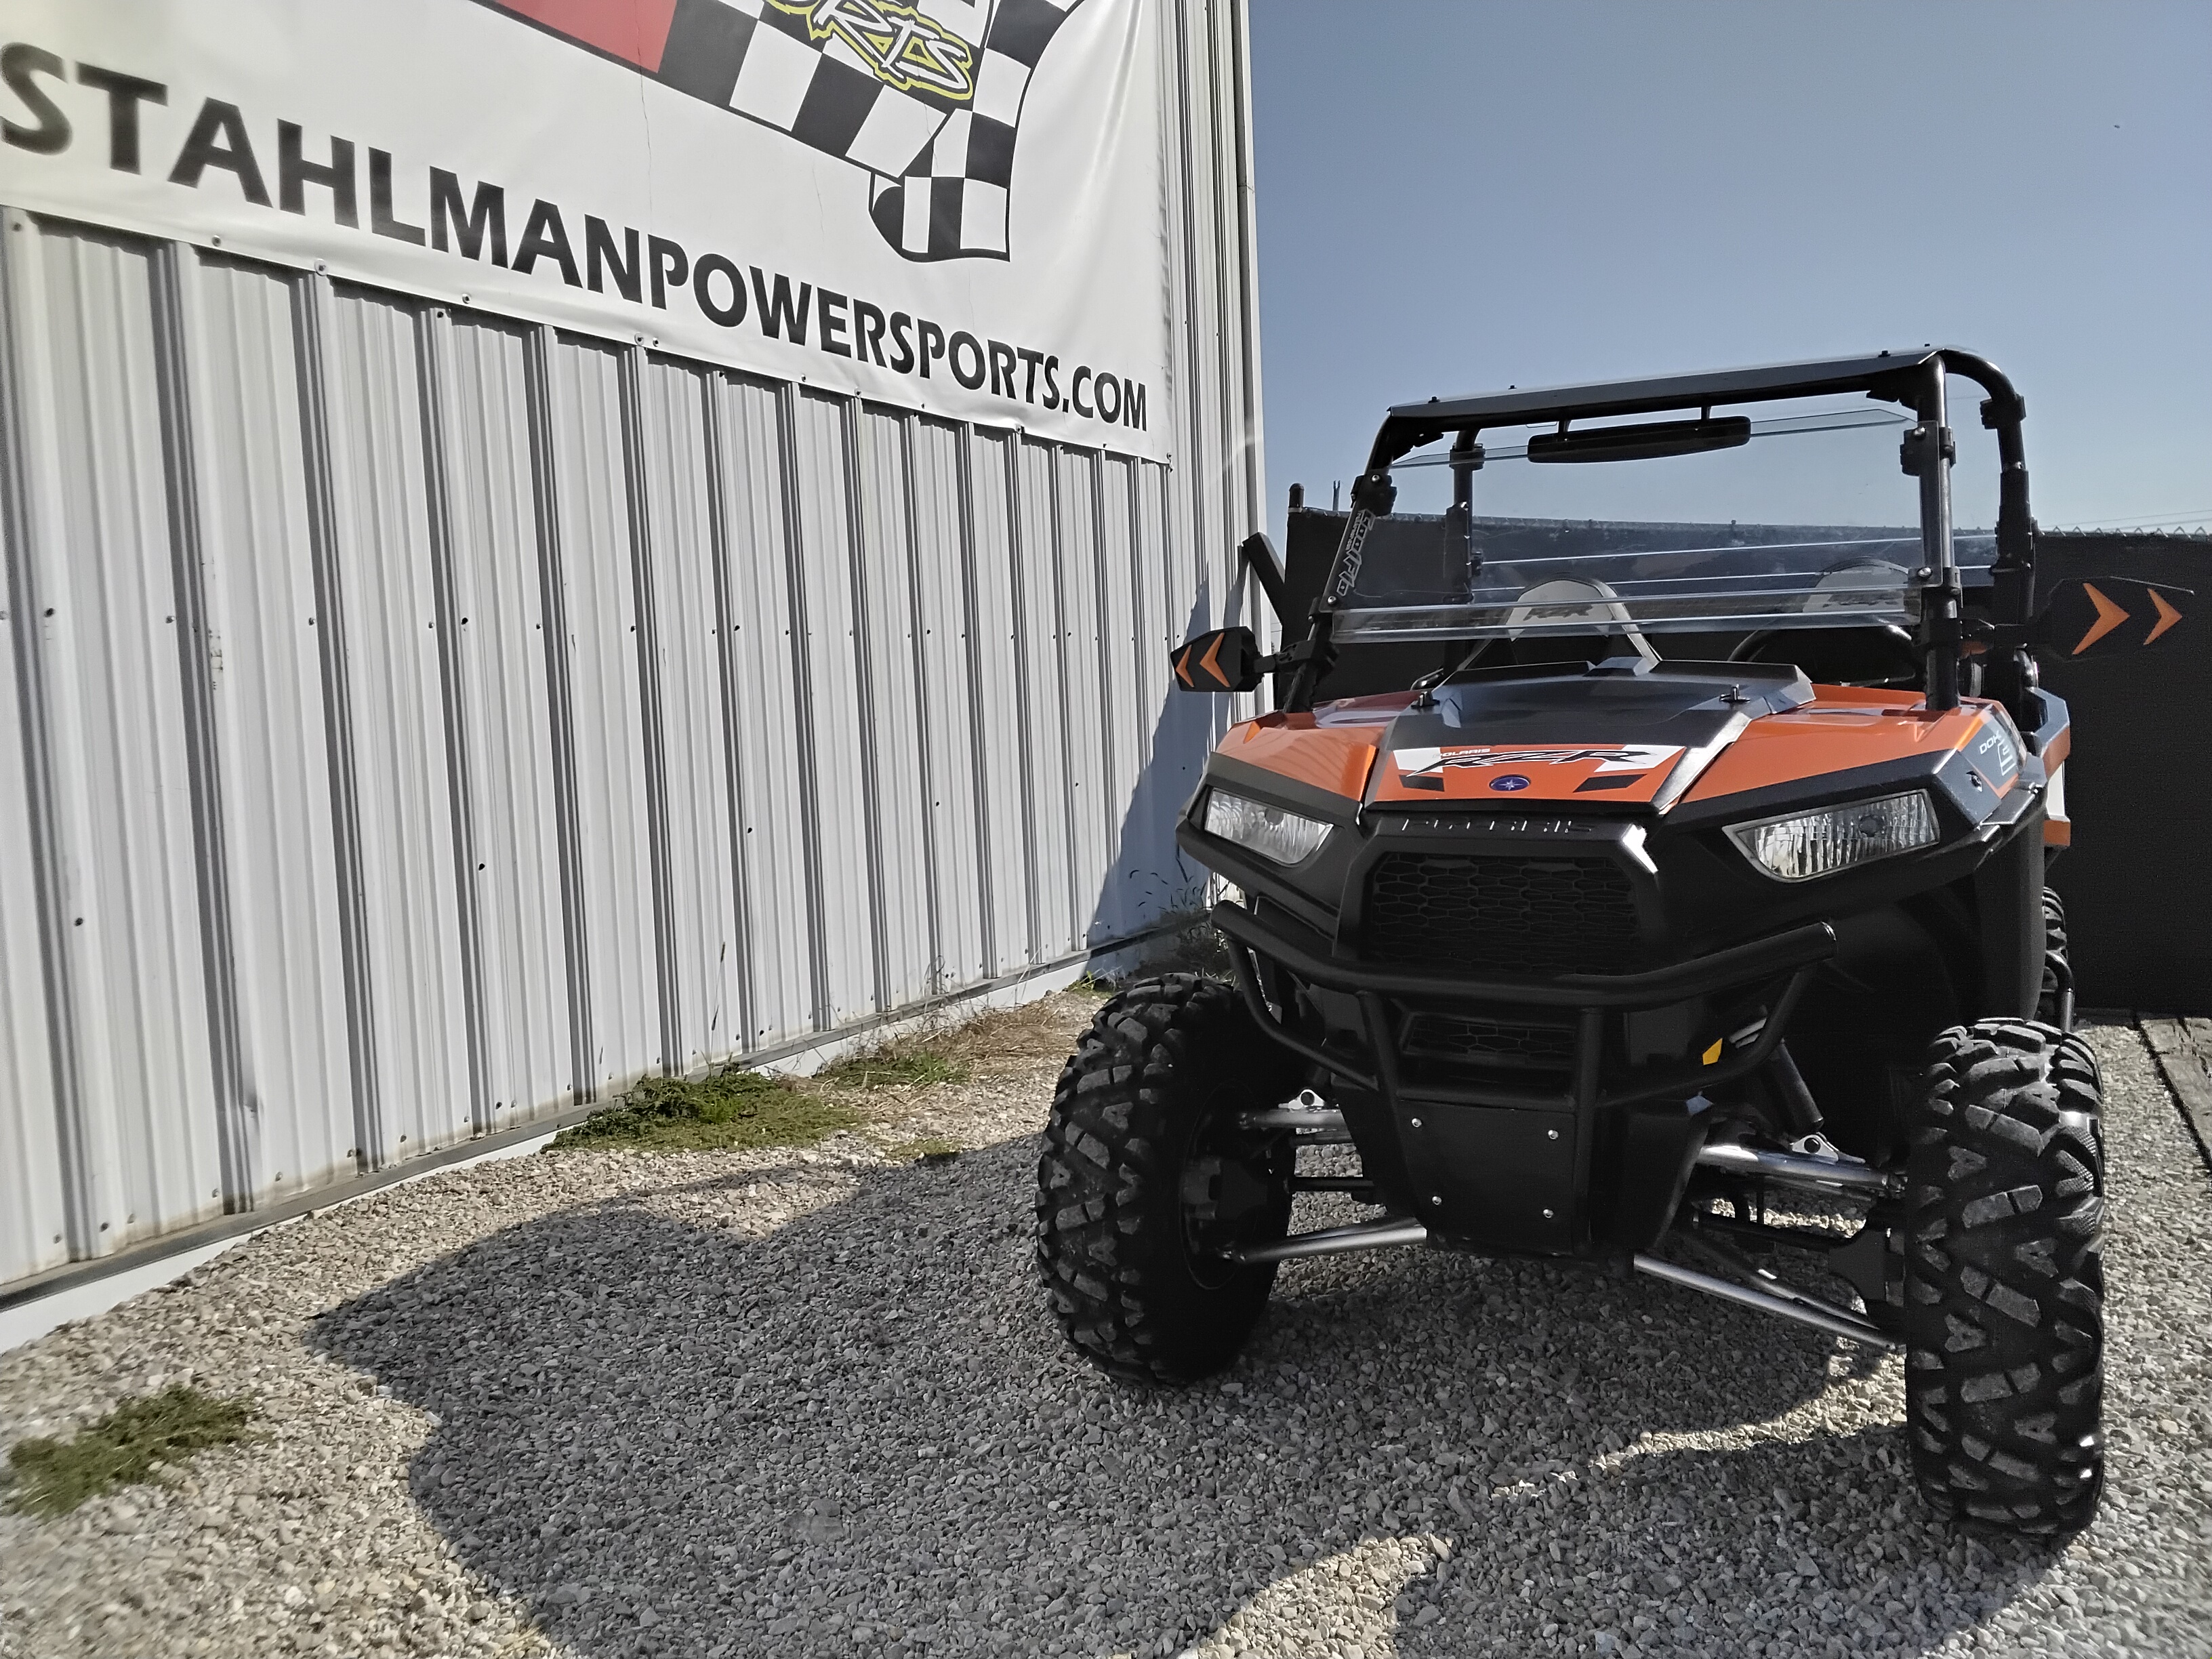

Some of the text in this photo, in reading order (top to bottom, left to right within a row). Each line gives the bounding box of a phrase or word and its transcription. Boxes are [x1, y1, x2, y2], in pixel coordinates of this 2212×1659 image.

[764, 0, 972, 97] RTS
[1, 41, 1147, 432] STAHLMANPOWERSPORTS.COM
[1406, 749, 1655, 777] RZR
